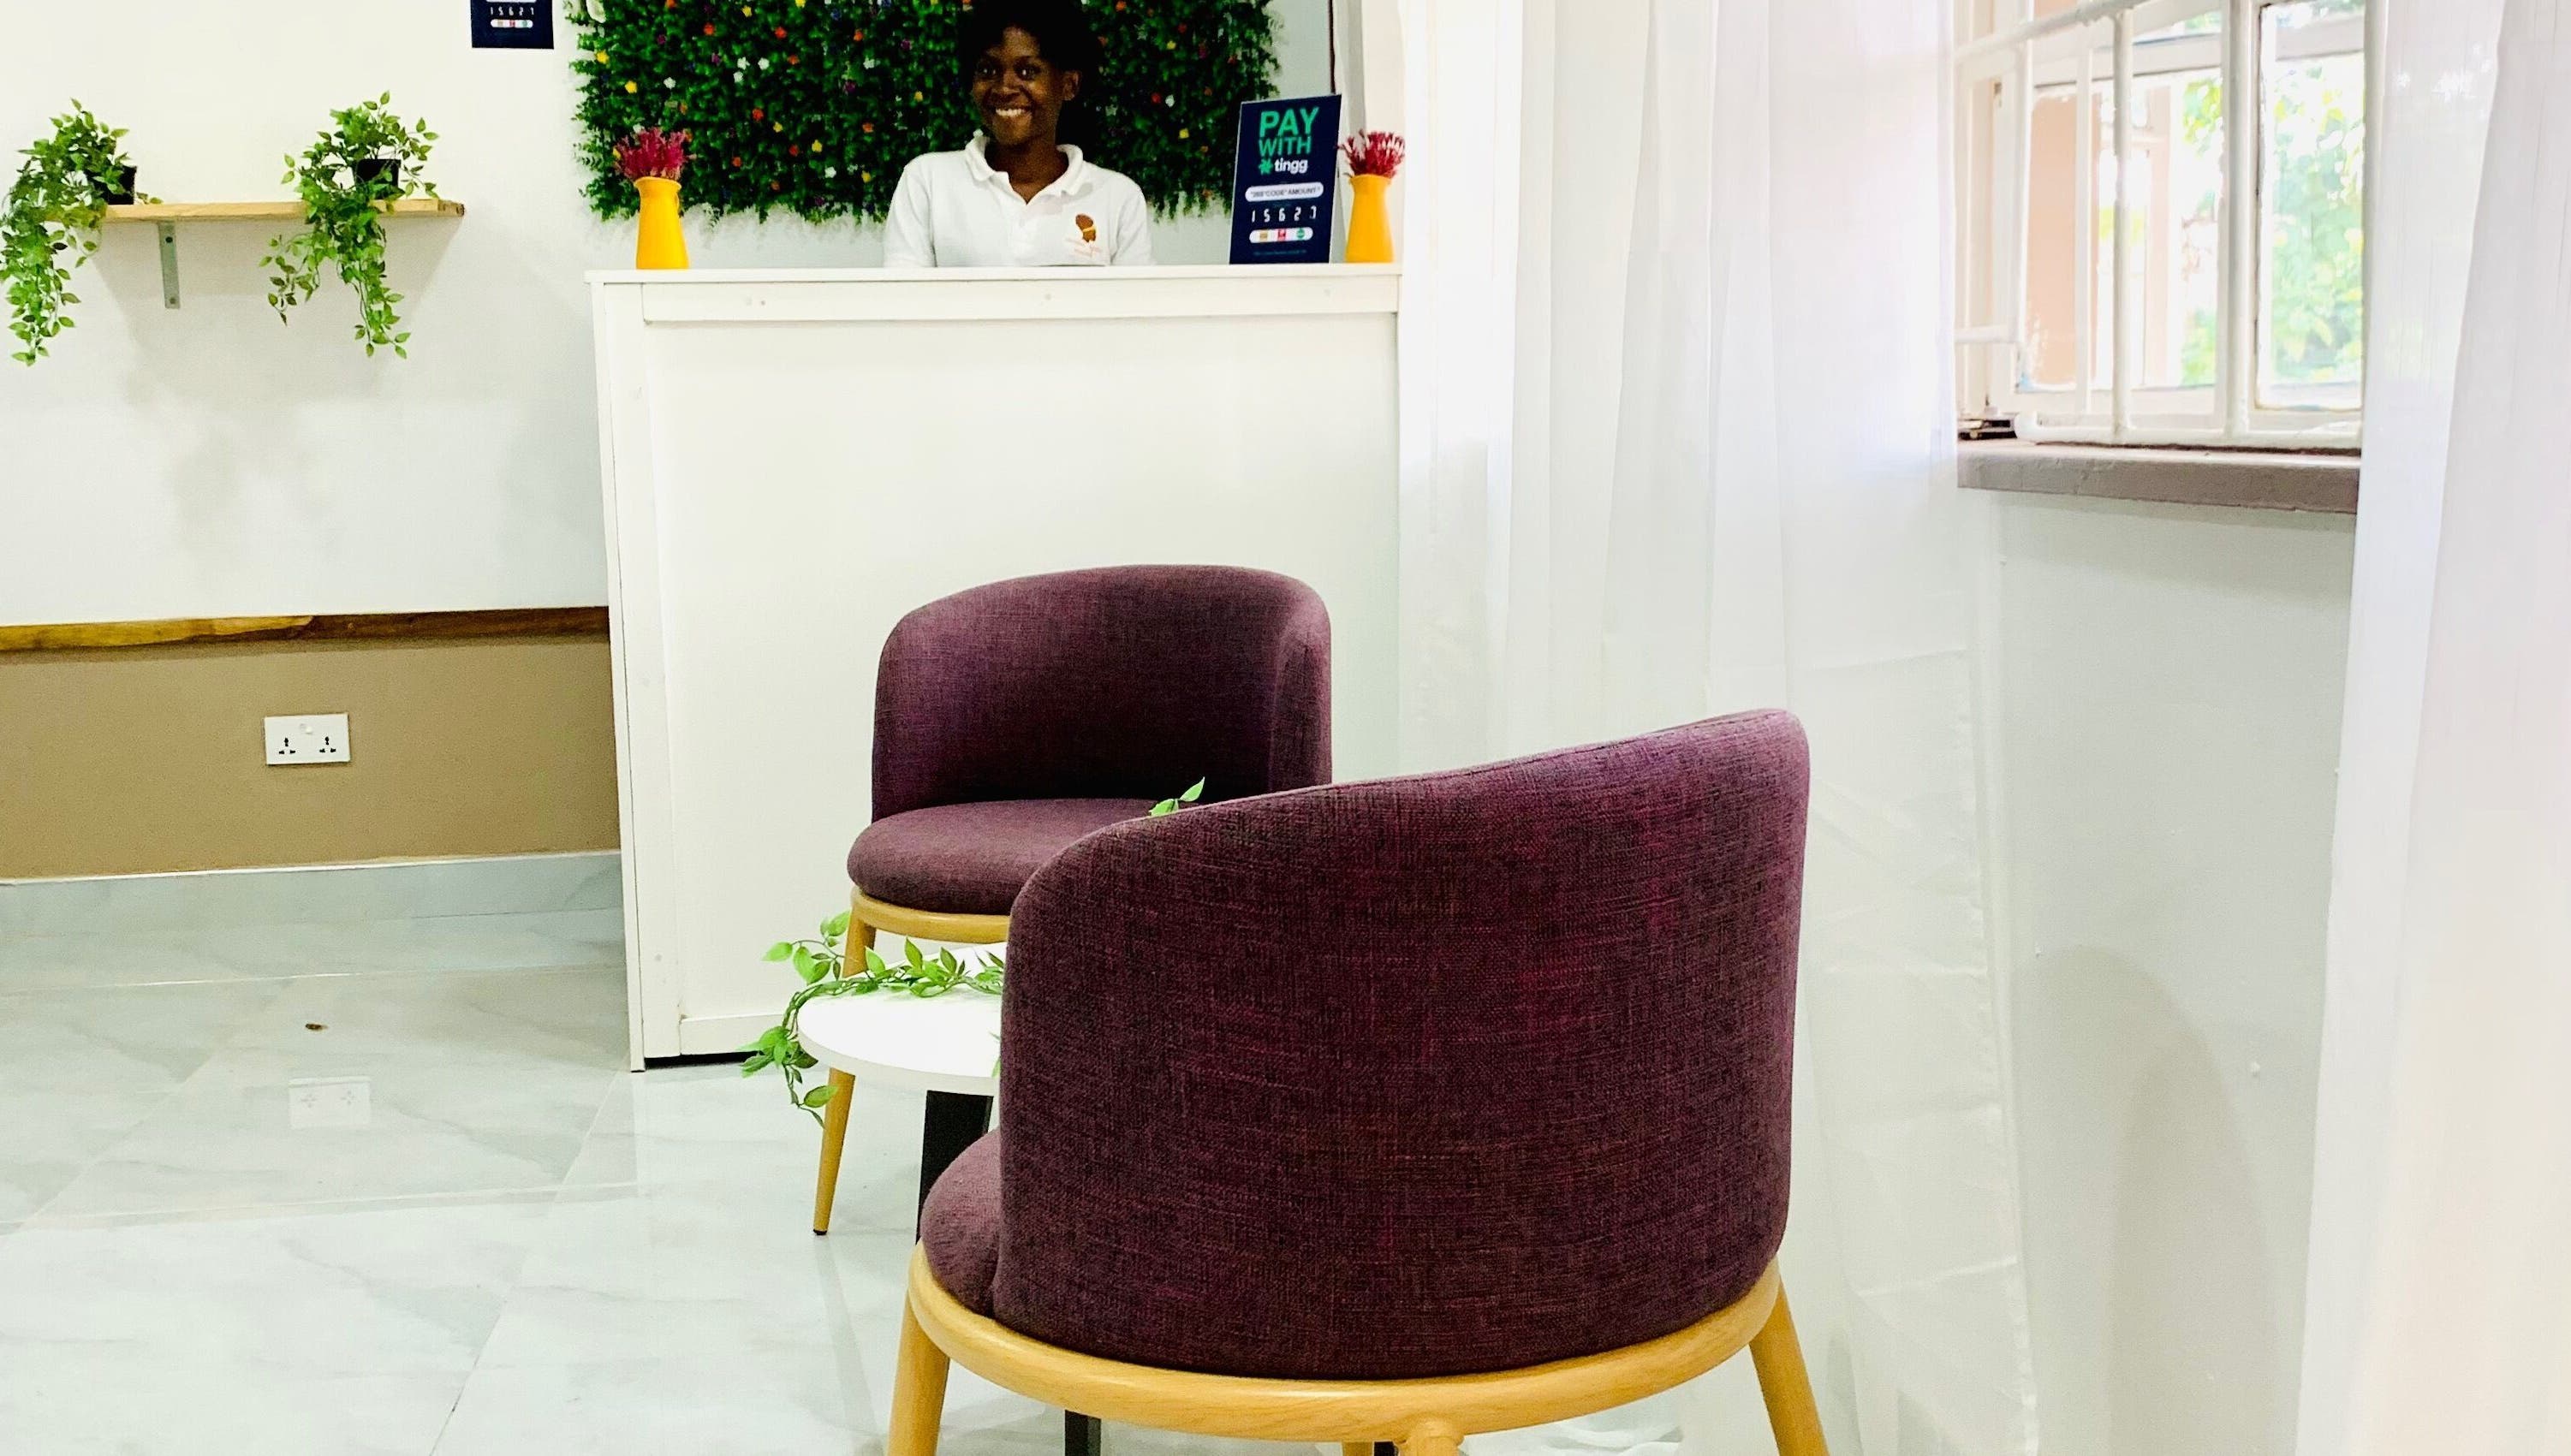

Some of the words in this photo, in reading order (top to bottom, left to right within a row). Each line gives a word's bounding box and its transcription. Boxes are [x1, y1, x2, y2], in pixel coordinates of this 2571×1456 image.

[1259, 107, 1319, 137] PAY
[1259, 136, 1312, 157] WITH
[1274, 157, 1308, 174] tingg
